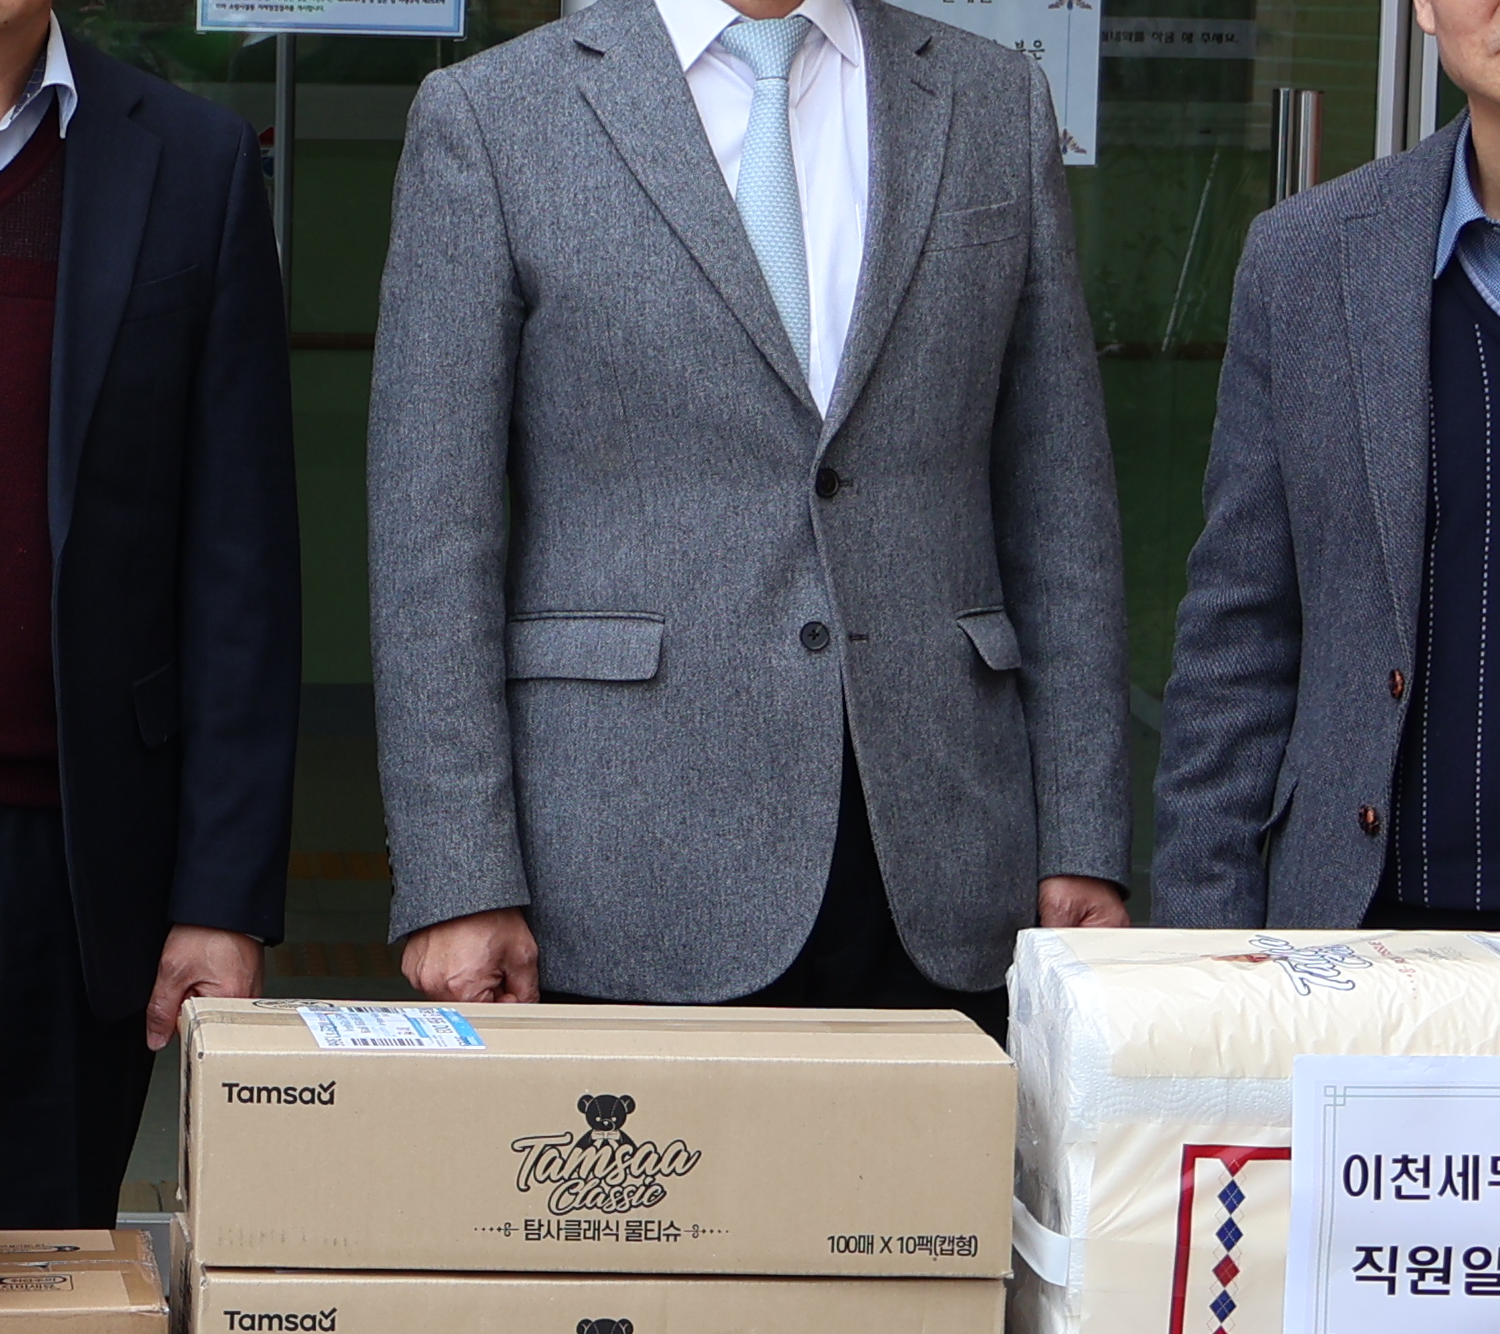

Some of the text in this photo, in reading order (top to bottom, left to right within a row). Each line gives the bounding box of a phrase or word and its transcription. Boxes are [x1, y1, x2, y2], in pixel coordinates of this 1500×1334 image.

[512, 1132, 701, 1190] Tamsaa
[548, 1179, 666, 1215] Classic
[524, 1217, 682, 1243] 탐사클래식 물티슈
[828, 1234, 979, 1259] 100매 X 10팩(캡형)
